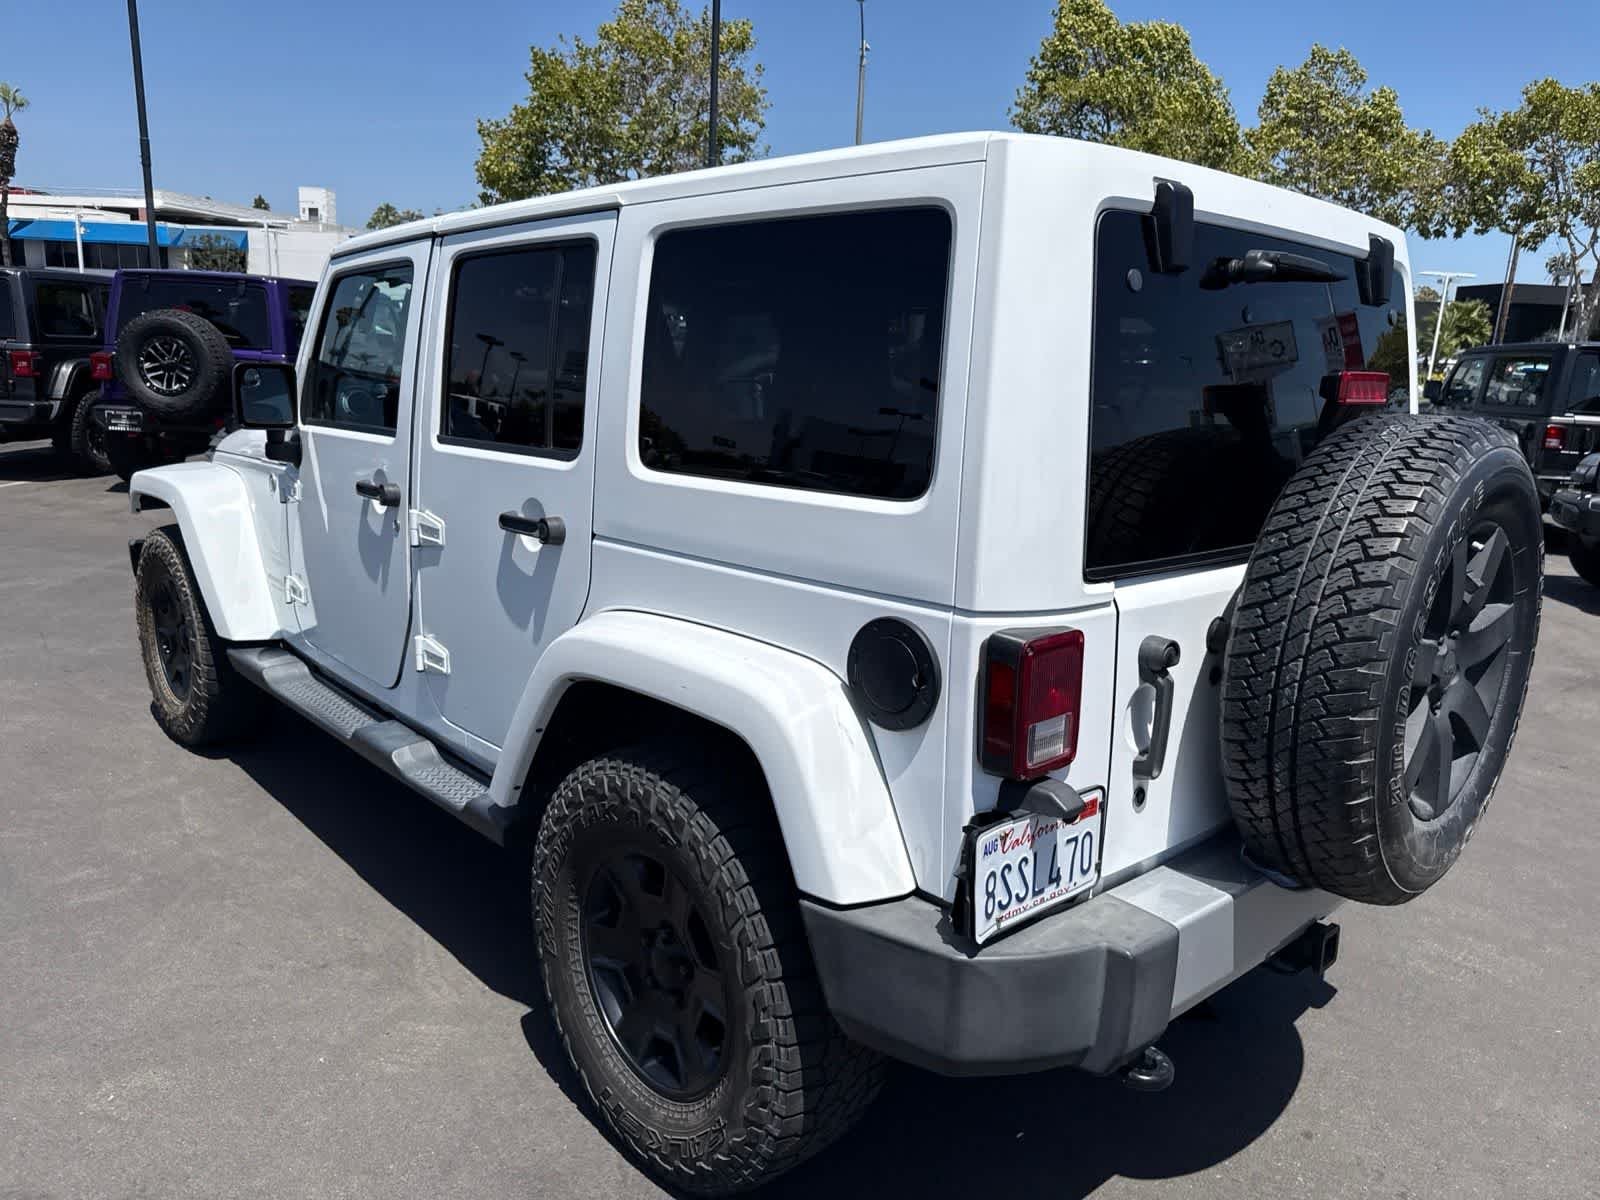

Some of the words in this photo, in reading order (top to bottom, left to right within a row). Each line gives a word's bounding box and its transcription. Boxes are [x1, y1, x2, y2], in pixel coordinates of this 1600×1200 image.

[984, 839, 999, 856] AUG
[1001, 817, 1078, 854] Californi
[984, 831, 1093, 920] 8SSL470
